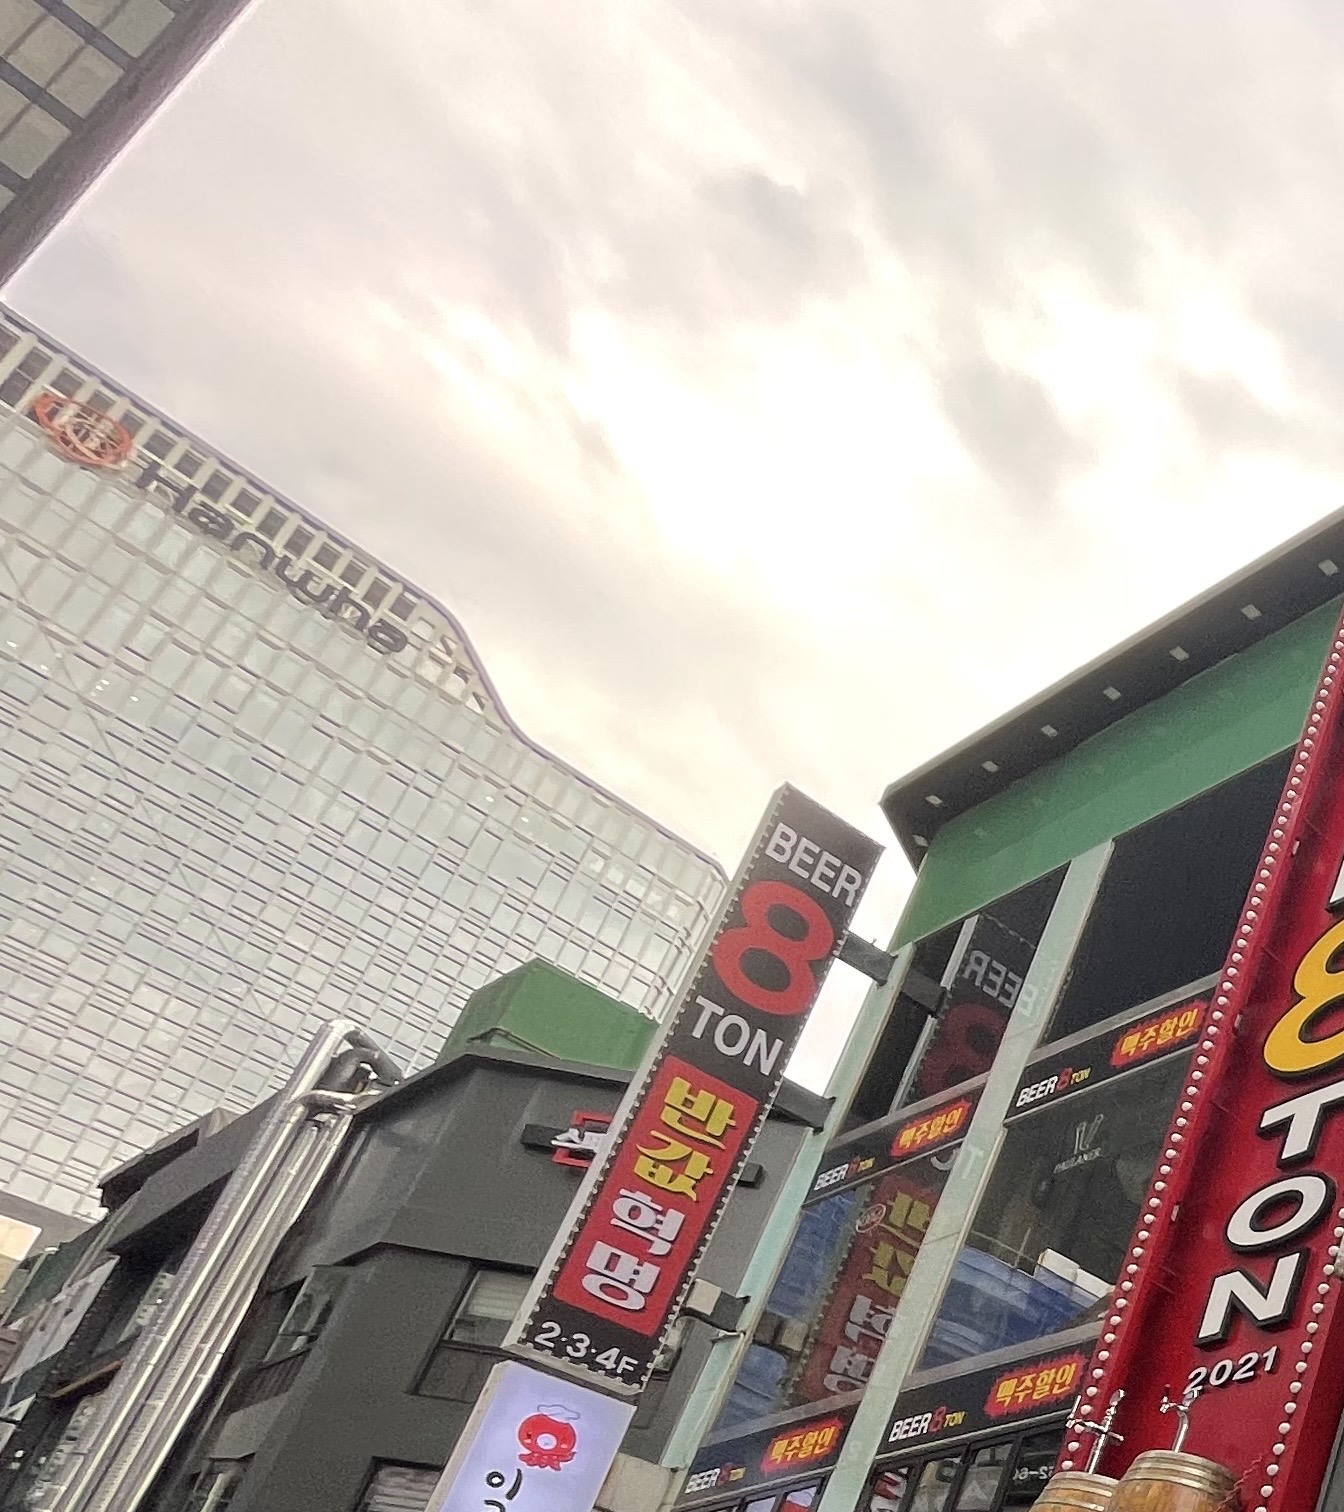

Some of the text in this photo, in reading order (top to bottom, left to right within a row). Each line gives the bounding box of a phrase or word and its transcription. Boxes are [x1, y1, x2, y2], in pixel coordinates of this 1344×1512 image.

[135, 461, 408, 655] Hanwha
[765, 822, 862, 906] BEER
[712, 880, 835, 1016] 8
[692, 996, 784, 1077] TON
[1119, 1008, 1199, 1056] 맥주할인
[634, 1076, 738, 1201] 반값
[571, 1187, 685, 1310] 혁명
[995, 1363, 1077, 1404] 맥주할인
[1184, 1346, 1277, 1396] 2021
